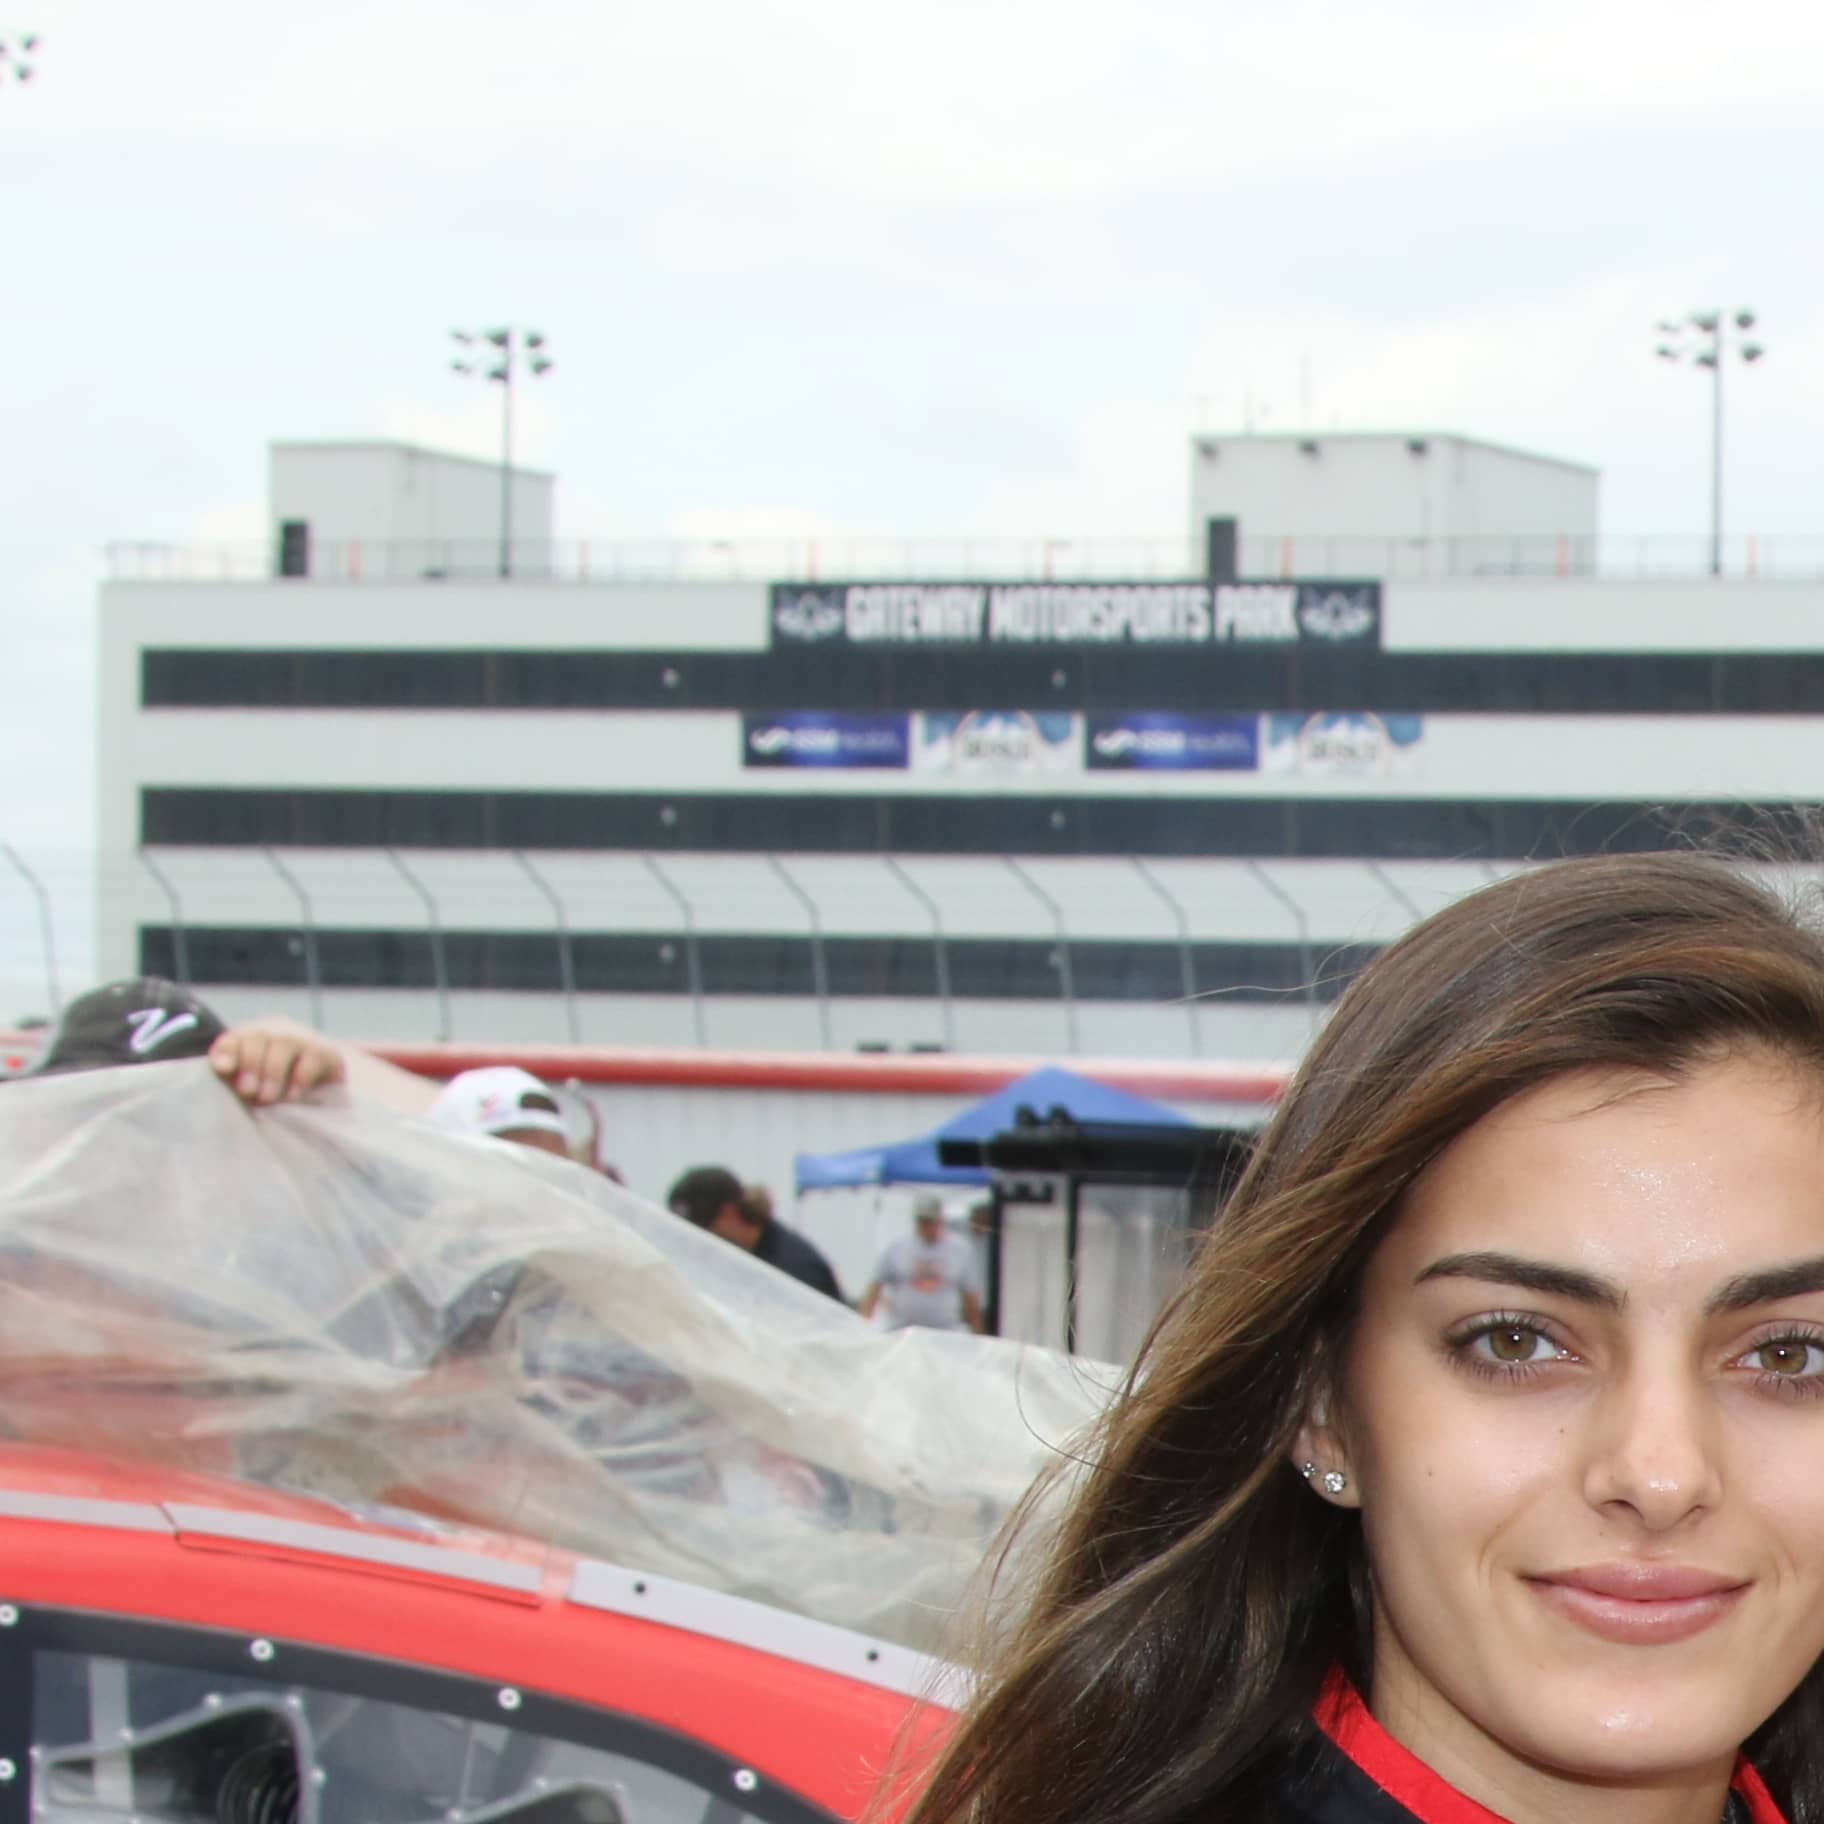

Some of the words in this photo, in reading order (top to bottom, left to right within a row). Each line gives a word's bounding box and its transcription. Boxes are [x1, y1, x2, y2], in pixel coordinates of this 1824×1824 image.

[846, 586, 988, 641] GATEWAY
[990, 586, 1212, 641] MOTORSPORTS
[1215, 586, 1298, 641] PARK
